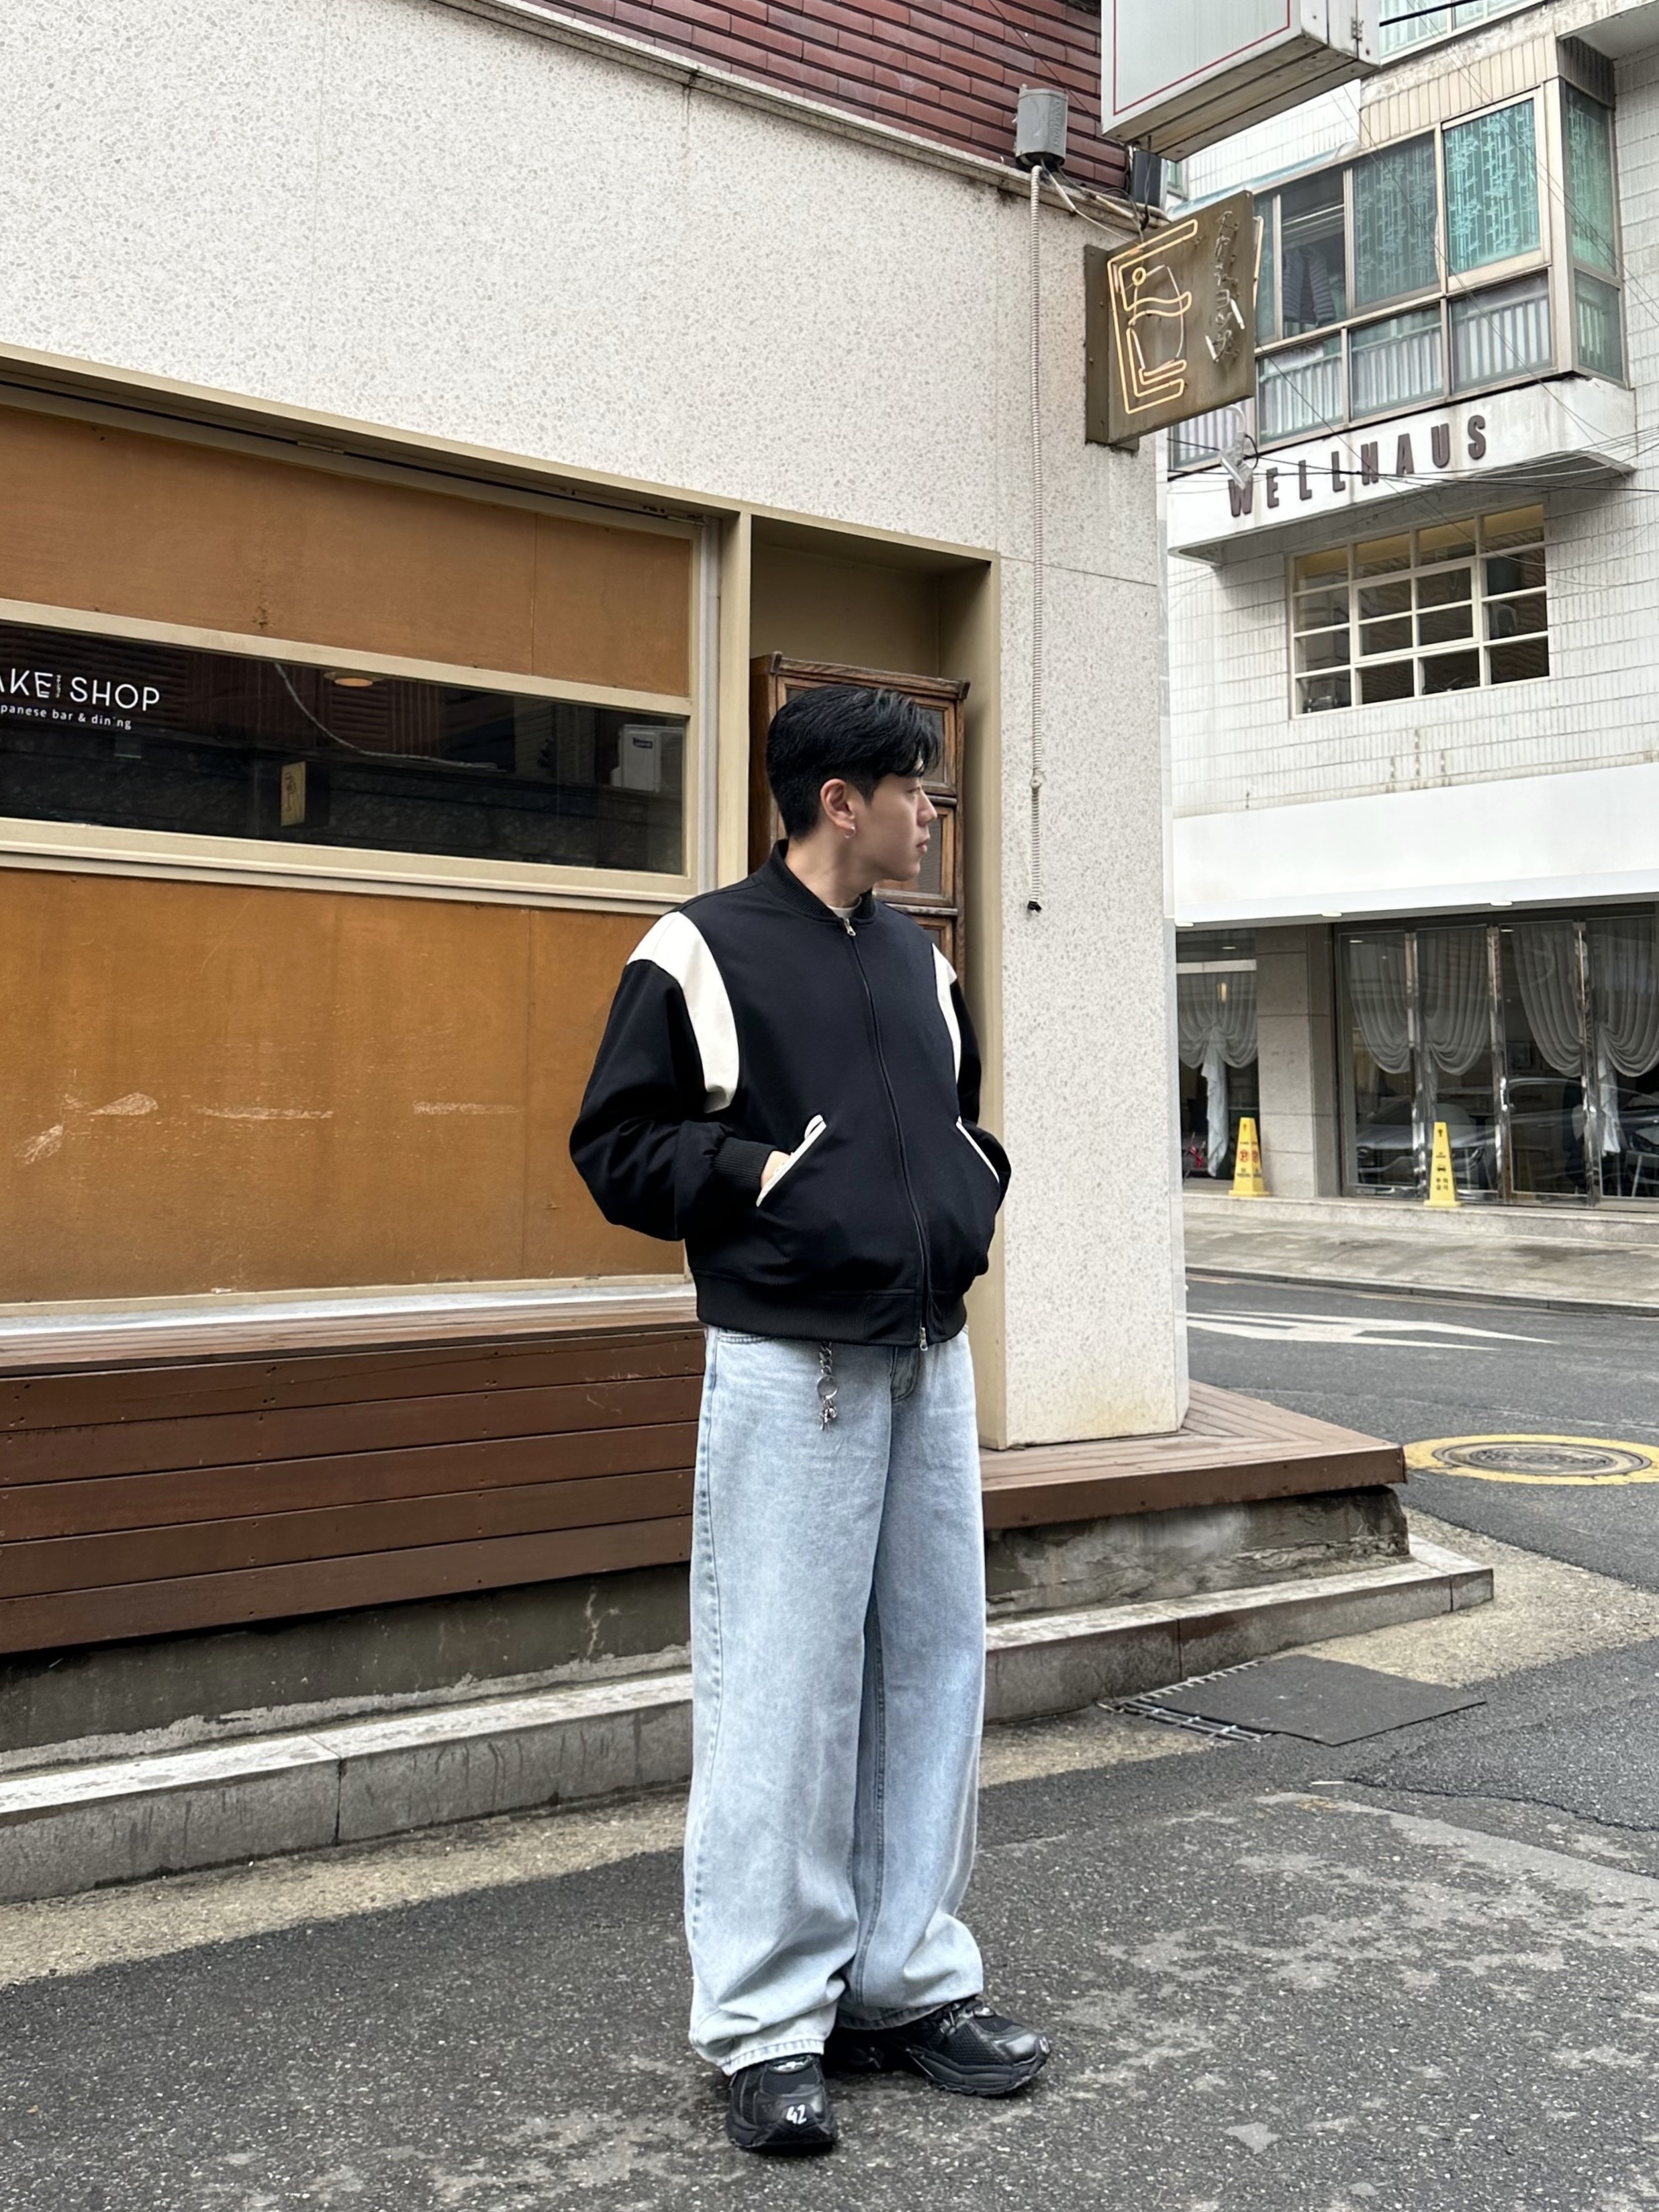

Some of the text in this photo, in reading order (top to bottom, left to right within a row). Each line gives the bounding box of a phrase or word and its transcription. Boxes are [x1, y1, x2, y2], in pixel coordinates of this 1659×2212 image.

[1227, 414, 1486, 518] WELLHAUS
[0, 667, 53, 698] KE
[70, 676, 160, 712] SHOP
[52, 708, 73, 721] bar
[78, 712, 86, 723] &
[91, 714, 132, 731] dinng
[786, 2104, 807, 2125] 42
